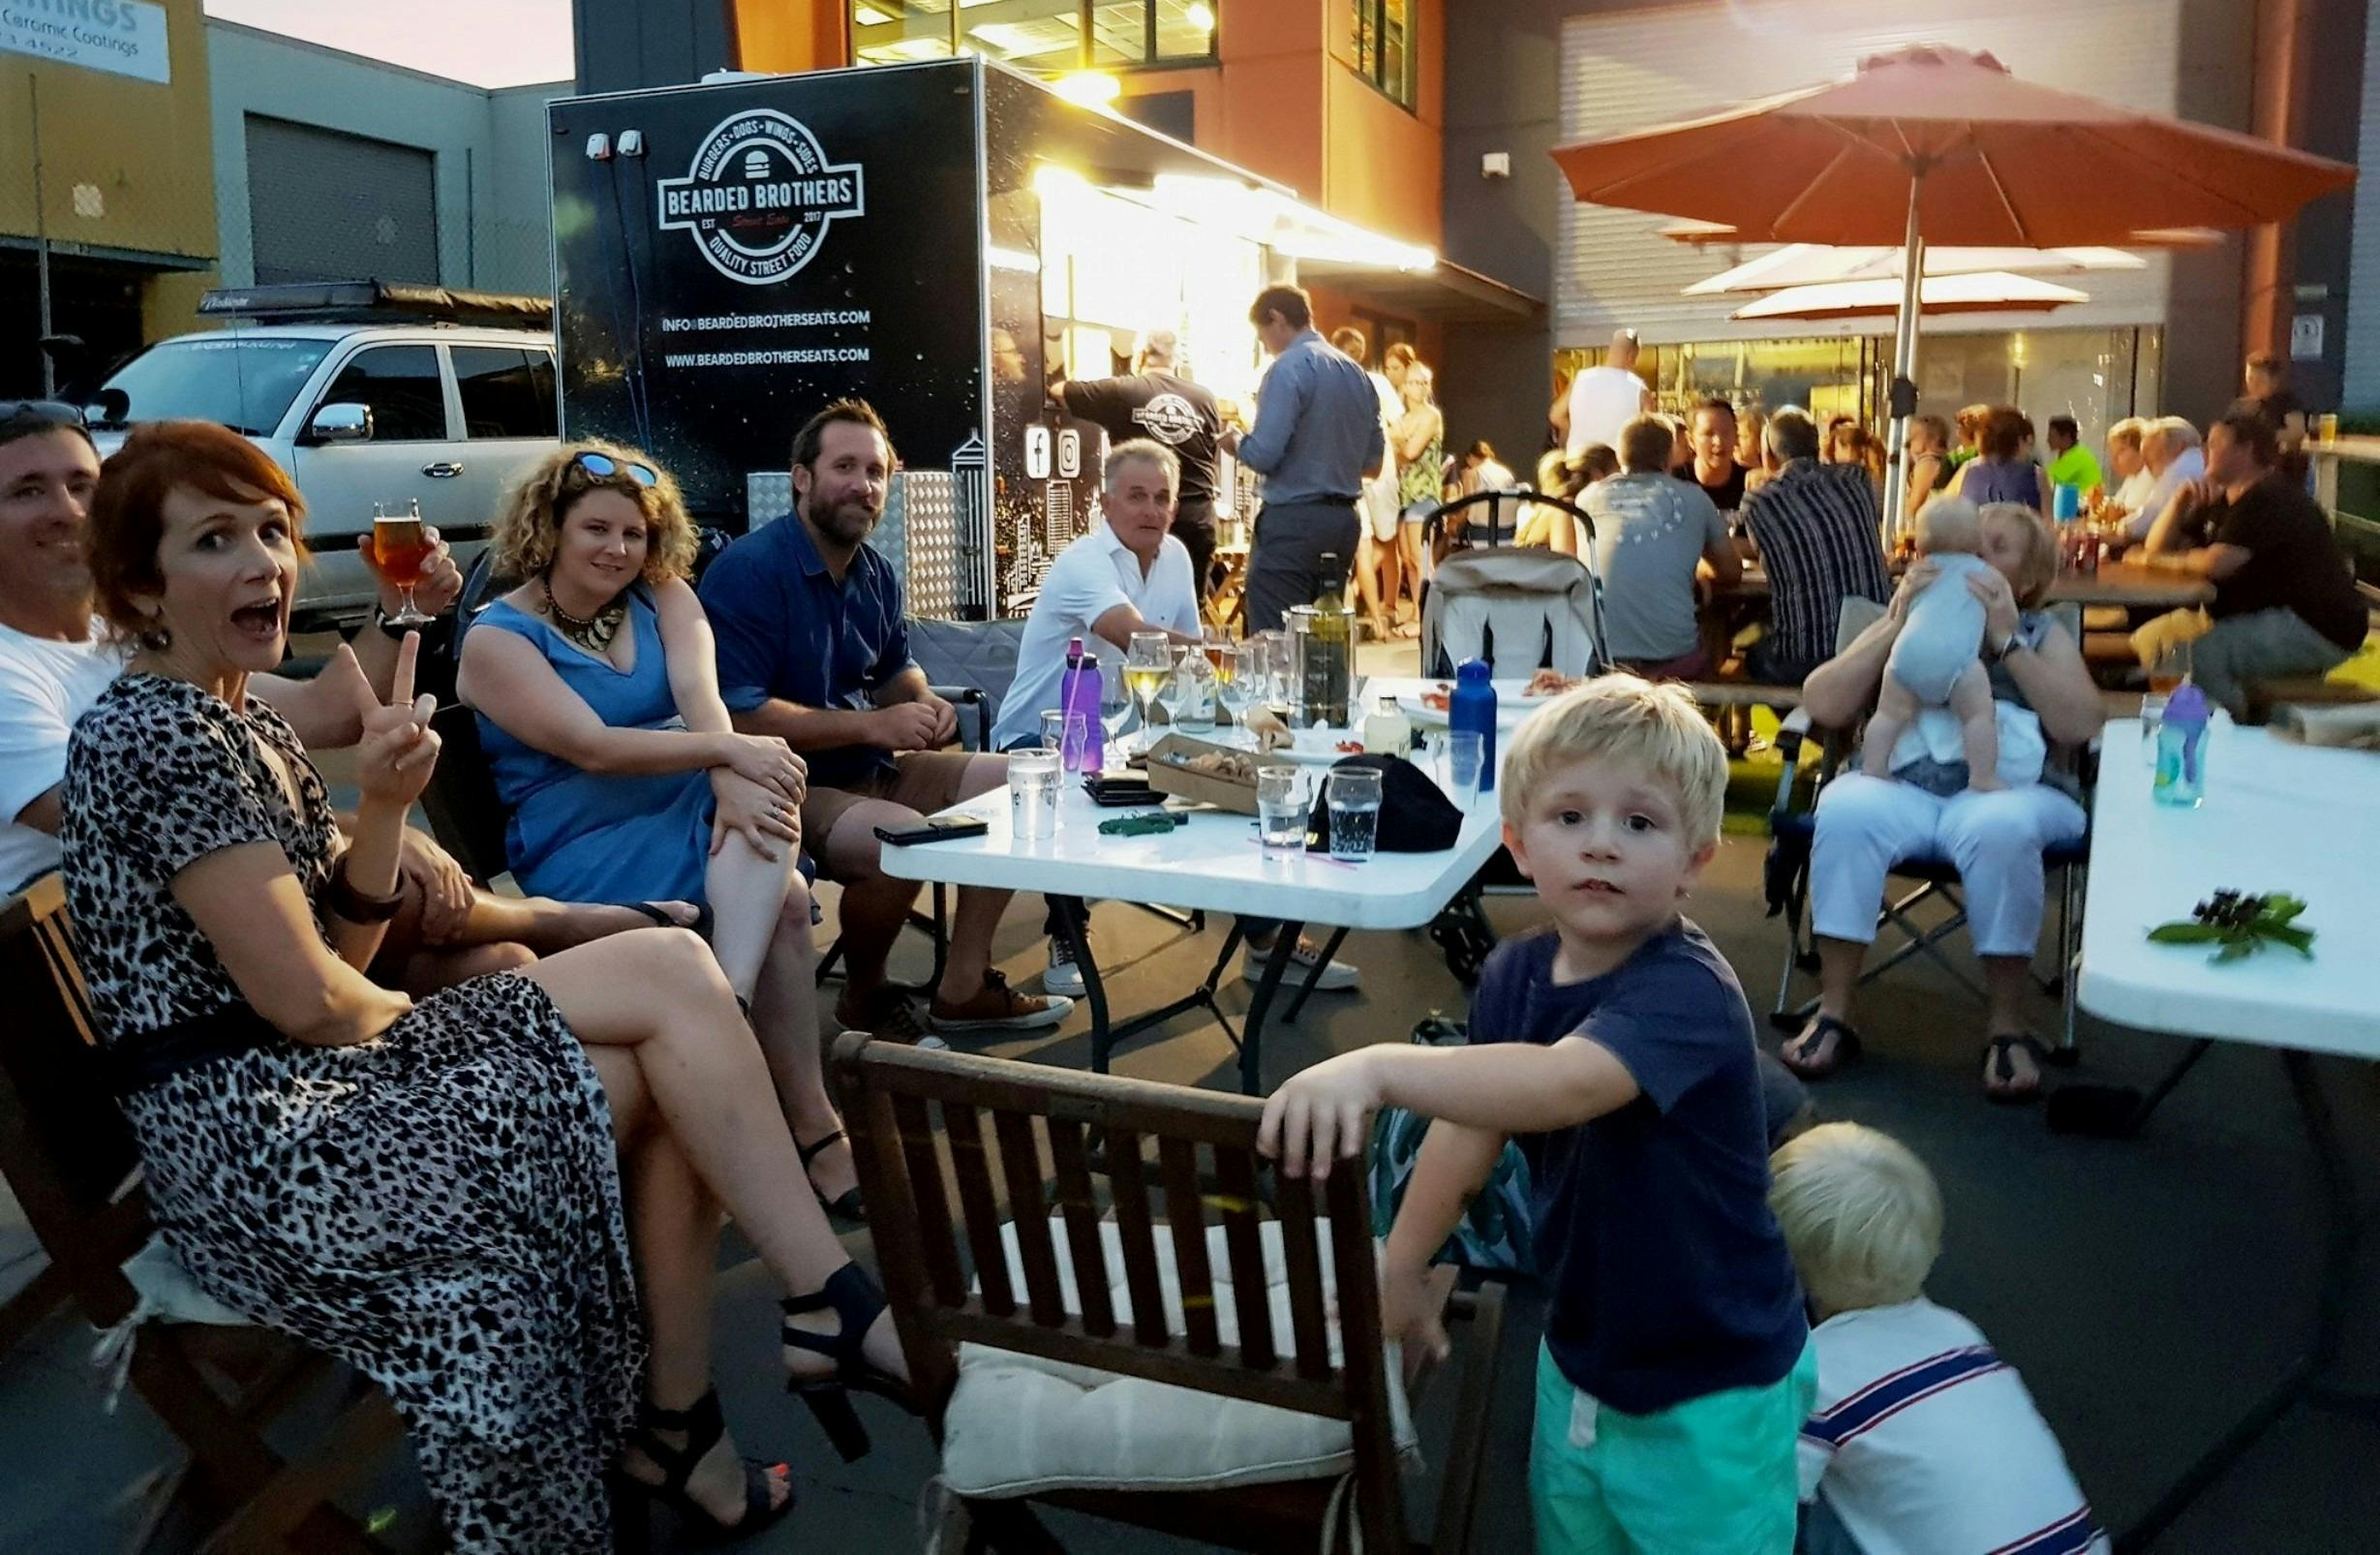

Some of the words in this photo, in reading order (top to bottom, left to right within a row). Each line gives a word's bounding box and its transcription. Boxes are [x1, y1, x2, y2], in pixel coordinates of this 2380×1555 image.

[2, 9, 70, 40] Ceramic
[73, 26, 139, 57] Coatings
[698, 134, 731, 180] BURGERS
[732, 120, 759, 139] DOGS
[765, 120, 796, 145] WINGS
[795, 141, 818, 174] SIDES
[667, 186, 749, 216] BEARDED
[754, 177, 853, 209] BROTHERS
[702, 218, 716, 230] EST
[709, 236, 748, 273] QUALITY
[749, 254, 788, 276] STREET
[786, 231, 812, 262] FOOD
[665, 348, 870, 368] WWW.BEARDEDBROTHERSEATS.COM
